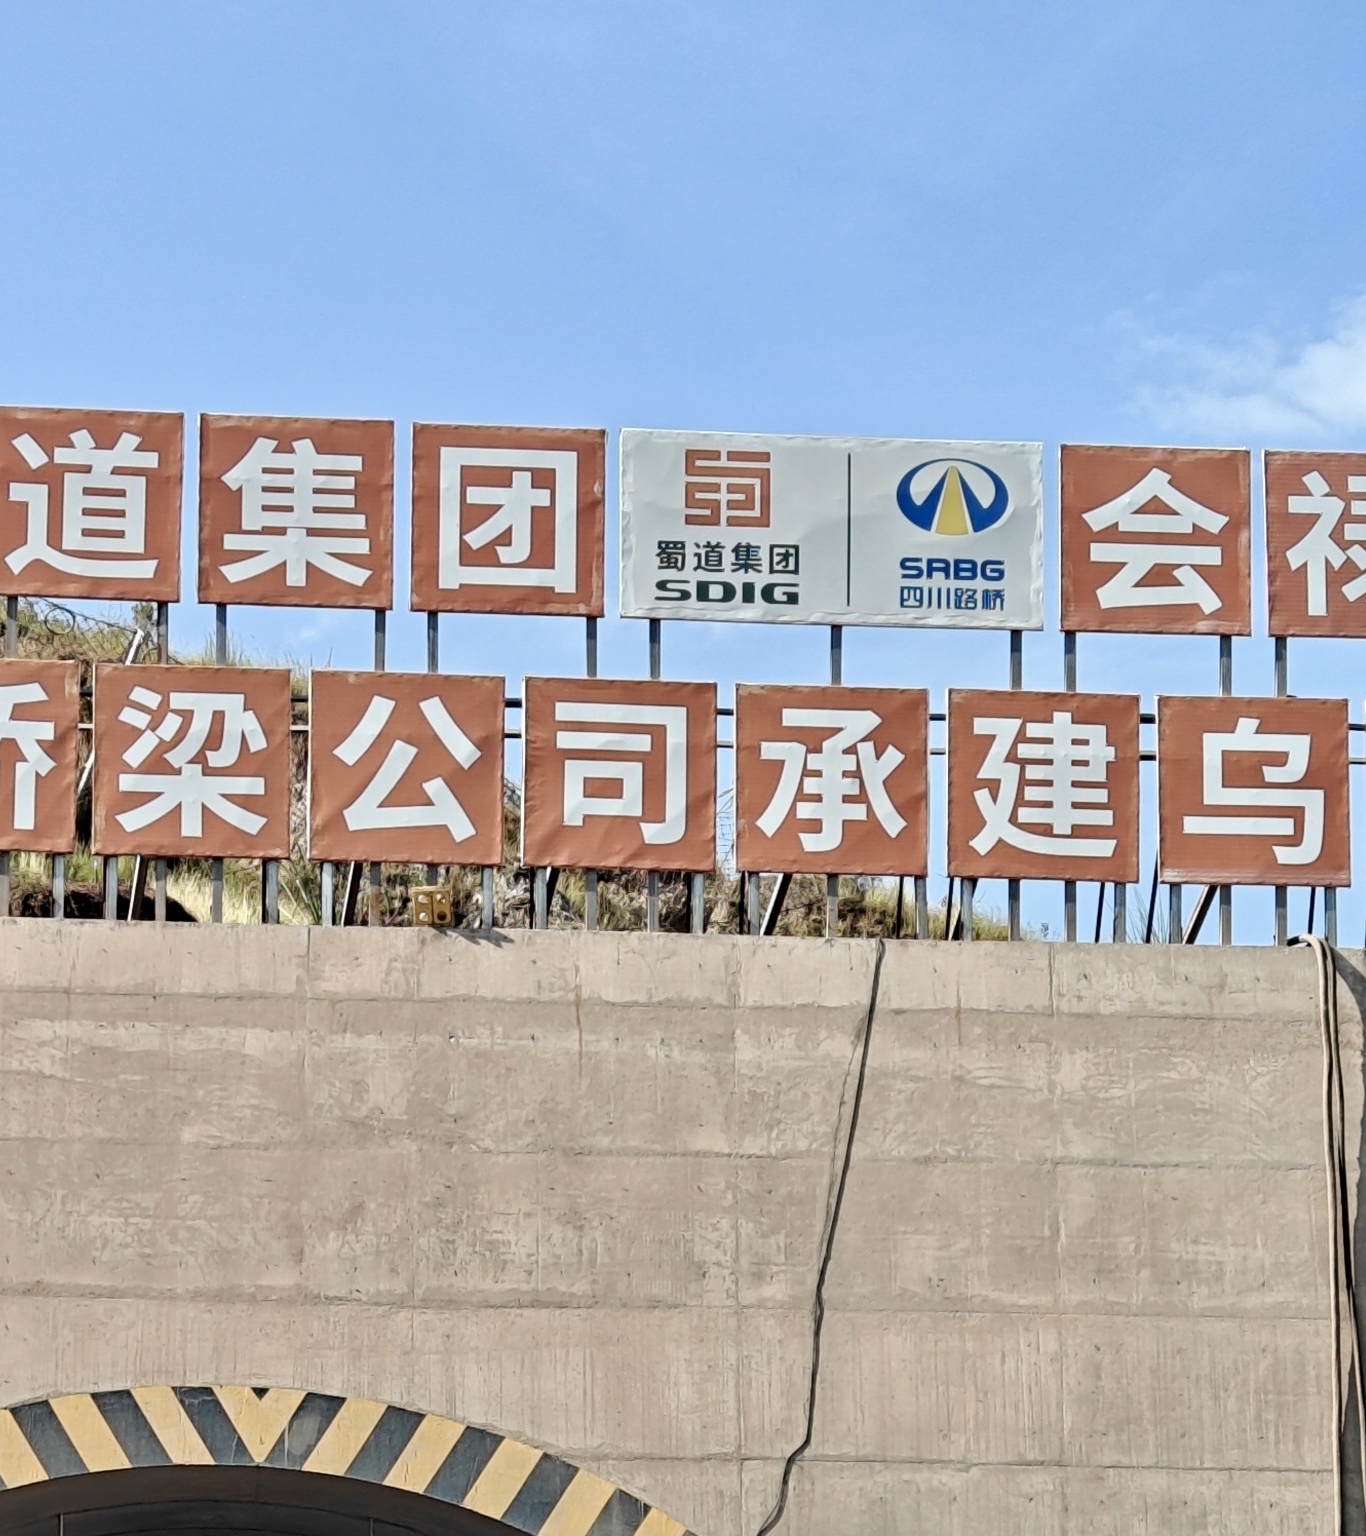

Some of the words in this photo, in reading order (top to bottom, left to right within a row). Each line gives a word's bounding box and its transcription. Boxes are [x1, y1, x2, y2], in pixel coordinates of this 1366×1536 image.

[655, 540, 800, 575] 蜀道集团
[899, 556, 1006, 582] SABG
[654, 580, 800, 605] SDIG
[899, 586, 1006, 612] 四川路桥
